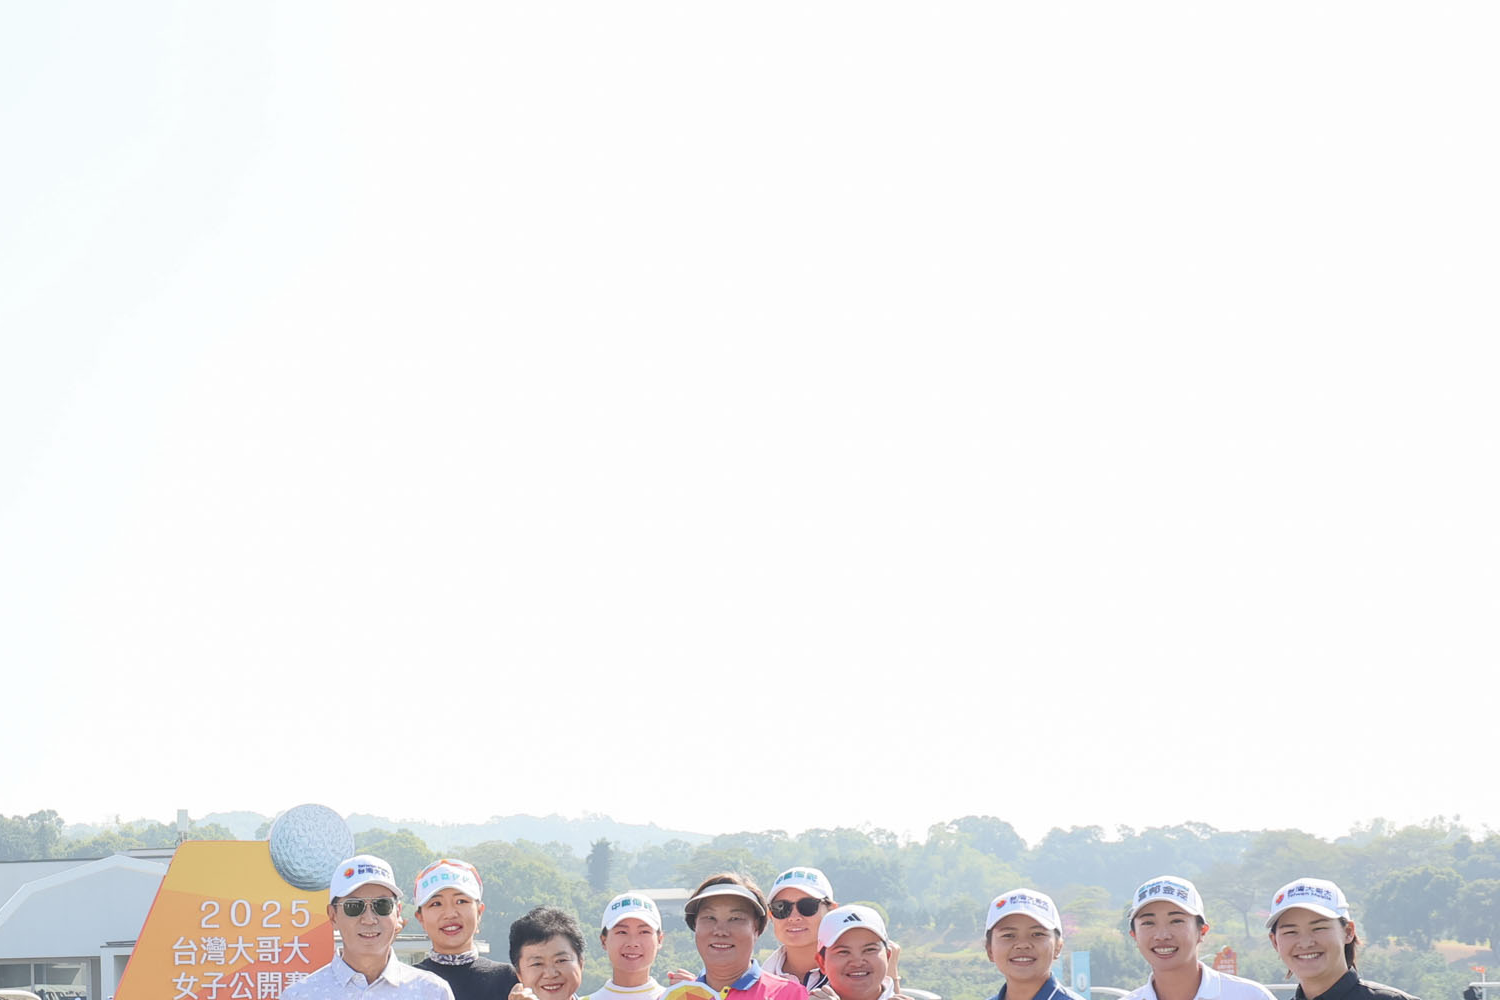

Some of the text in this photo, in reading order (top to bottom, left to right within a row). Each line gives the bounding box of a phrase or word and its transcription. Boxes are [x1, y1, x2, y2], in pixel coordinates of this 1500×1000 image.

[200, 899, 311, 929] 2025
[171, 936, 310, 966] 台灣大哥大
